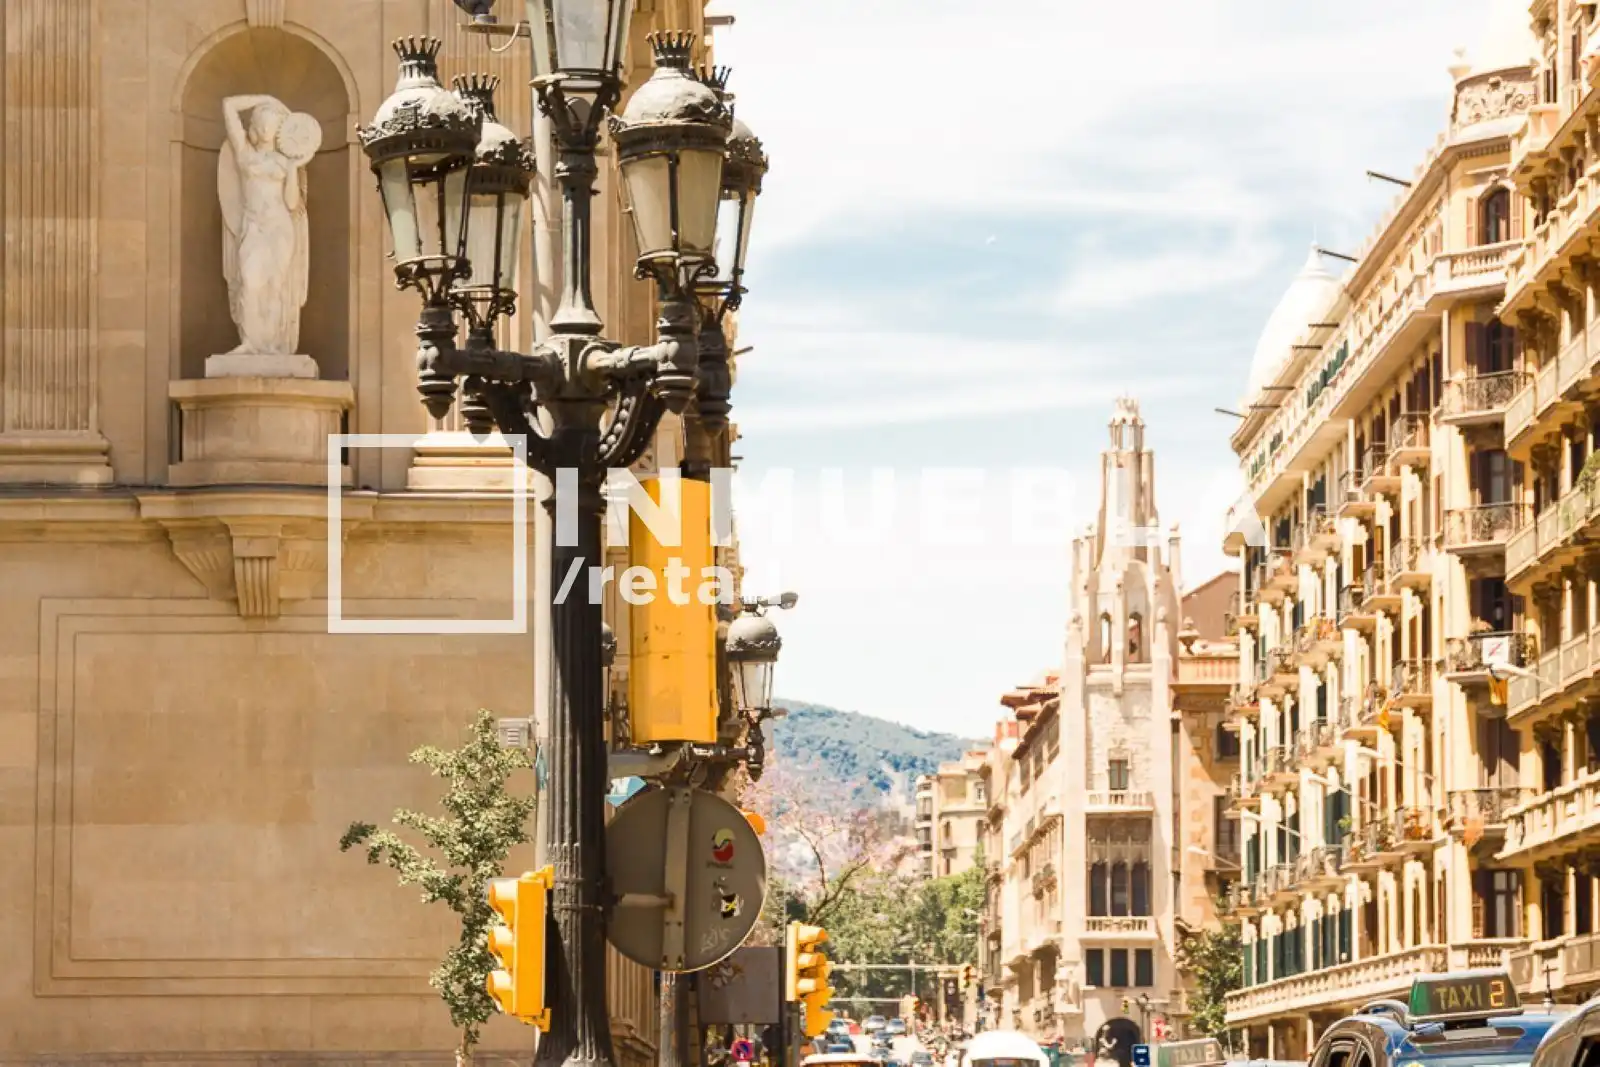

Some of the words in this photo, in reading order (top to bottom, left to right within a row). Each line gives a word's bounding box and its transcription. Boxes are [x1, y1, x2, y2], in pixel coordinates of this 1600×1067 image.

[1435, 984, 1482, 1010] TAXI
[1490, 980, 1505, 1007] 2
[1174, 1044, 1203, 1061] TAXI
